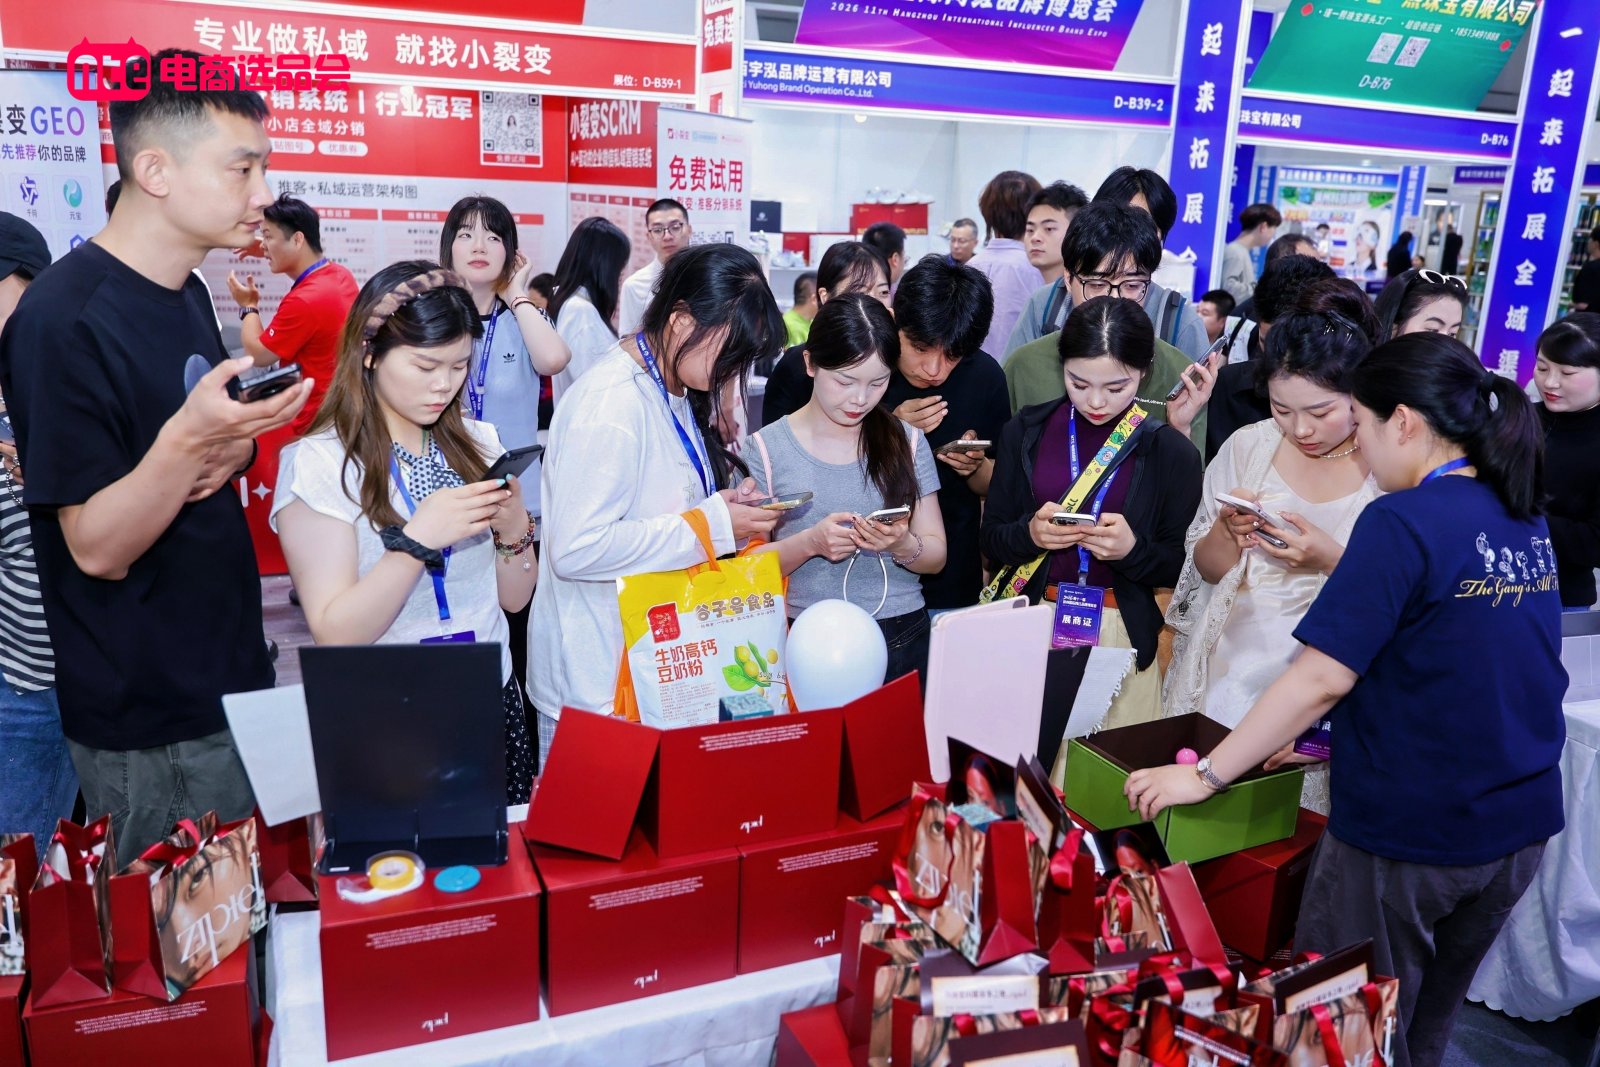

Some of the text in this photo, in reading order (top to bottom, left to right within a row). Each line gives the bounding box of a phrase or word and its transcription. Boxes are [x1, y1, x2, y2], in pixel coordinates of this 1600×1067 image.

[830, 2, 1108, 38] 2026 11TH HANGZHOU INTERNATIONAL INFLUENCER BRAND EXPO
[1401, 0, 1536, 26] 珠宝有限公司
[193, 17, 552, 75] 专业做私域 就找小裂变
[643, 78, 682, 90] D-B39-1
[749, 80, 778, 93] Yuhong
[780, 83, 802, 93] Brand
[804, 85, 843, 96] Operation
[1358, 75, 1393, 90] D-B76
[262, 90, 348, 114] 销系统
[375, 91, 473, 120] 行业冠军
[1114, 96, 1164, 111] D-B39-2
[262, 117, 365, 137] 小店全域分销
[570, 101, 642, 141] 小裂变SCRM
[1240, 110, 1302, 129] 珠宝有限公司
[1481, 133, 1508, 146] D-B76
[0, 143, 87, 163] 先推荐你的品牌
[669, 154, 743, 193] 免费试用
[278, 180, 418, 199] 推客+私域运营架构图
[672, 196, 743, 212] 变·推客分销系统
[1454, 574, 1494, 598] The
[1532, 572, 1550, 593] All
[1062, 614, 1093, 628] 展商证
[654, 638, 719, 666] 牛奶高钙
[656, 659, 705, 684] 豆奶粉
